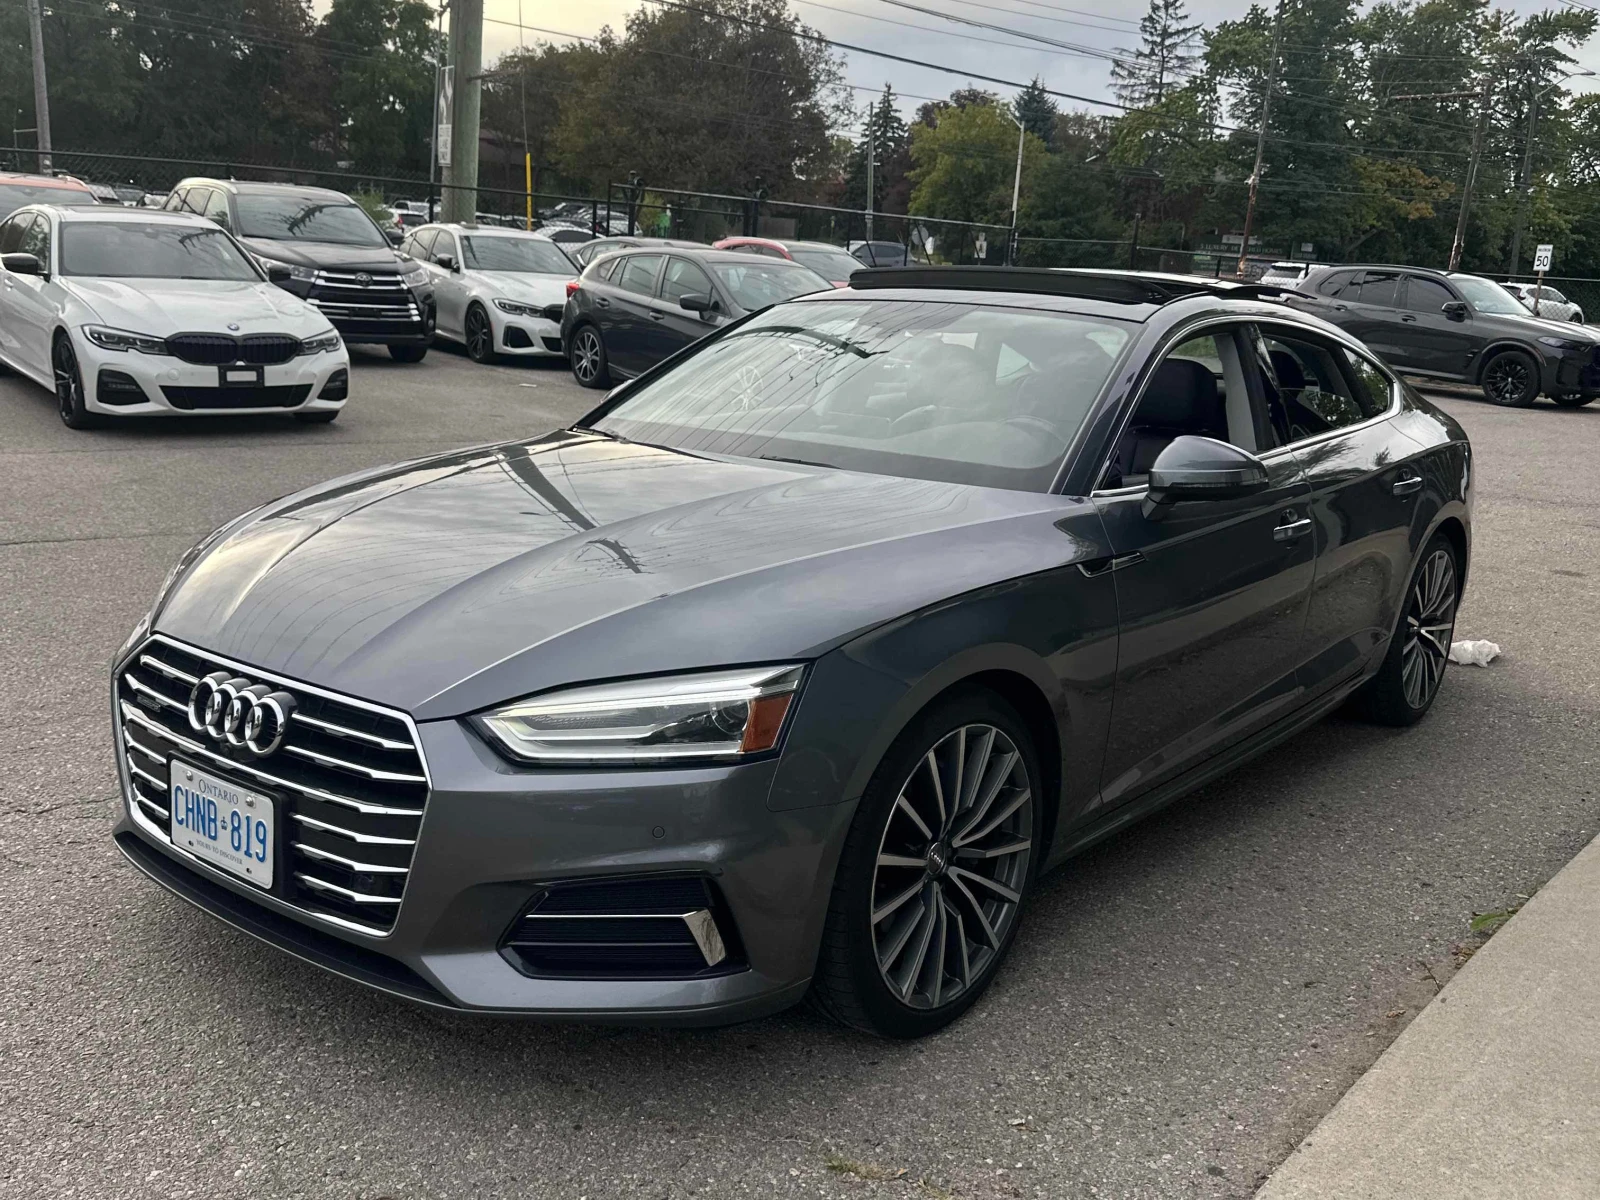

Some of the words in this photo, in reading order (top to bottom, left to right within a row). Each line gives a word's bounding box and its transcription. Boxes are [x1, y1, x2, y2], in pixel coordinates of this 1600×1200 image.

[1536, 256, 1548, 267] 50
[199, 779, 239, 805] ONTARIO
[174, 784, 218, 841] CHNB
[230, 809, 267, 863] 819
[196, 839, 212, 850] YOURS
[212, 846, 219, 855] TO
[220, 849, 243, 864] DISCOVER
